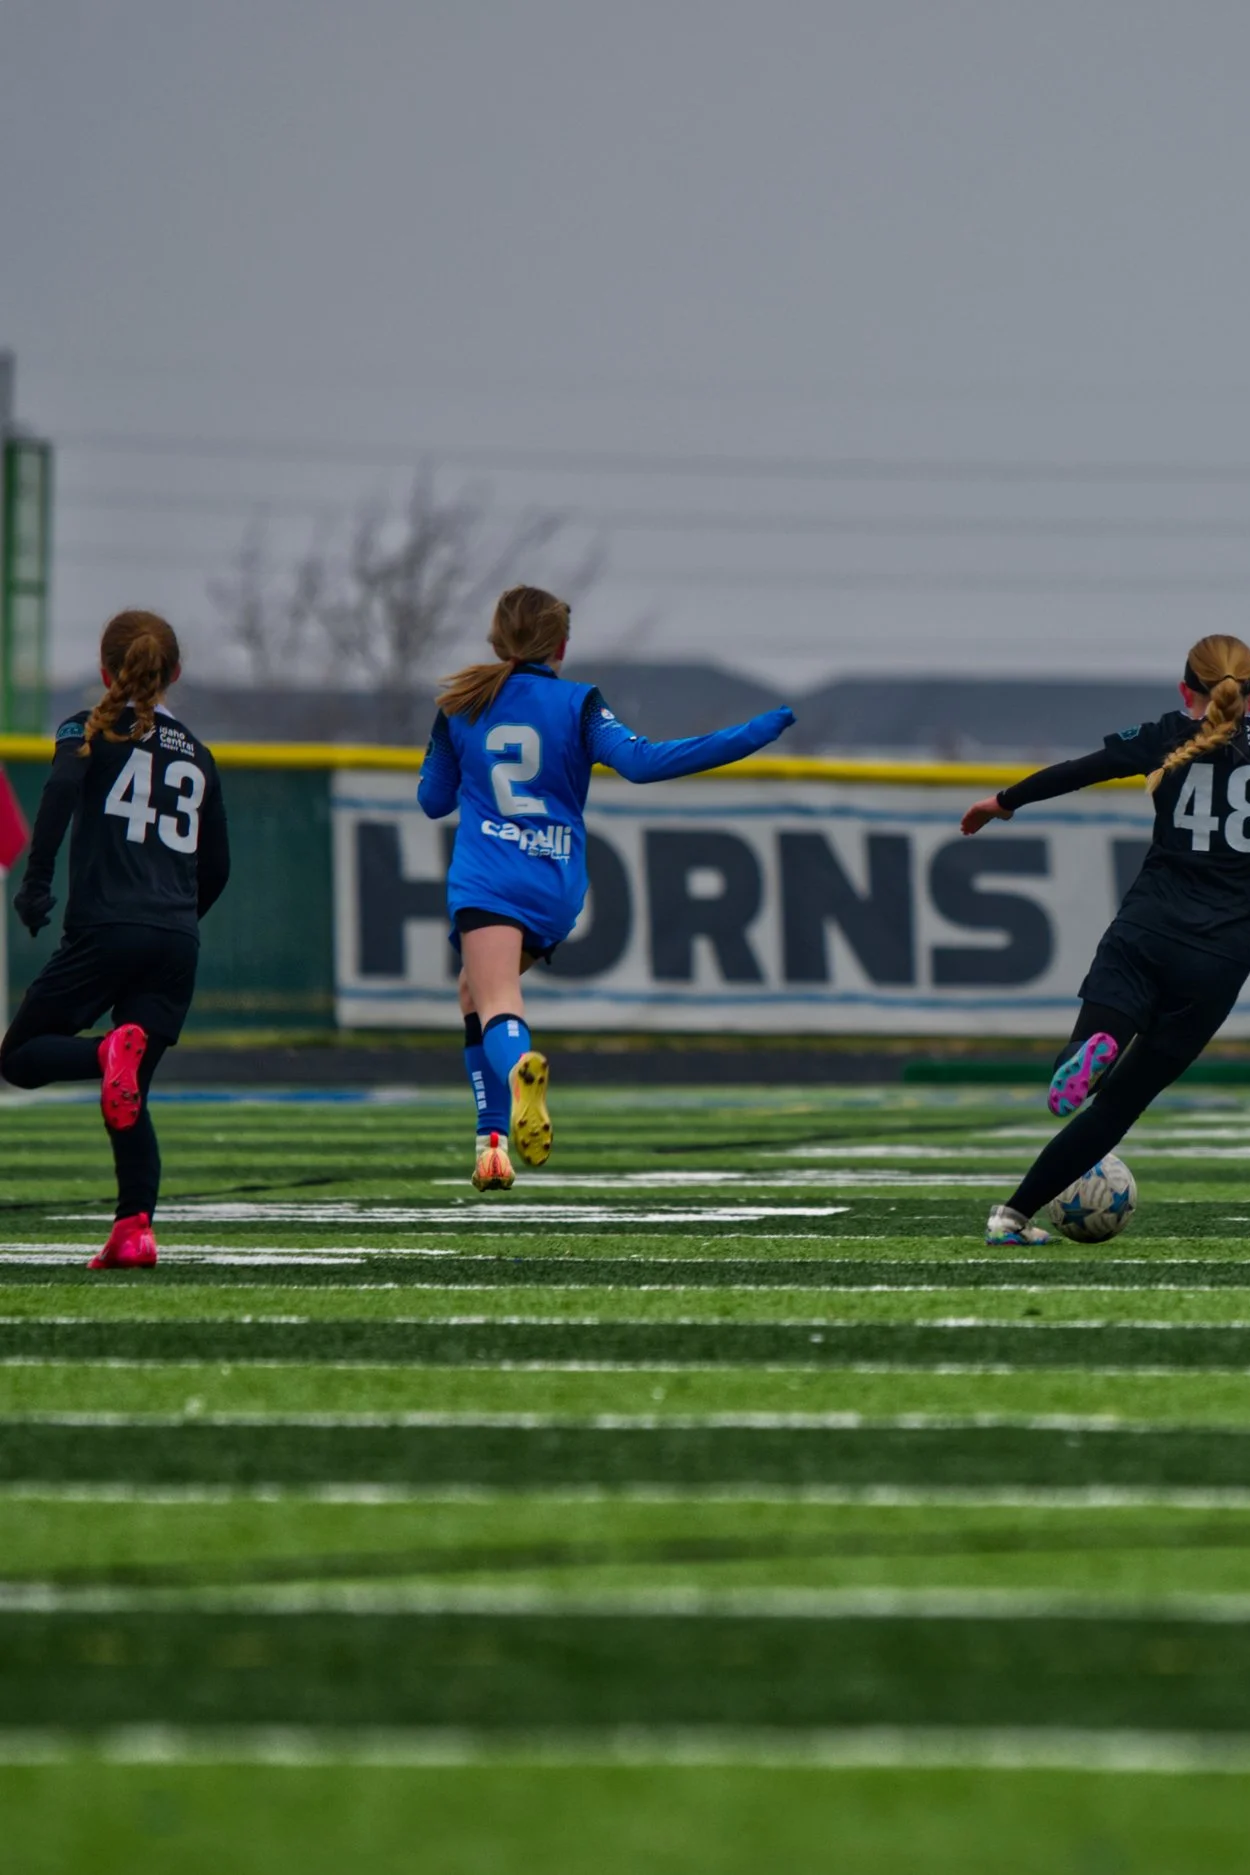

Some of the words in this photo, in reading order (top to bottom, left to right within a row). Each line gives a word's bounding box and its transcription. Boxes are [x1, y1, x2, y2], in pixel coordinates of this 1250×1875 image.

[160, 733, 195, 752] Central
[486, 723, 549, 818] 2
[104, 747, 207, 855] 43
